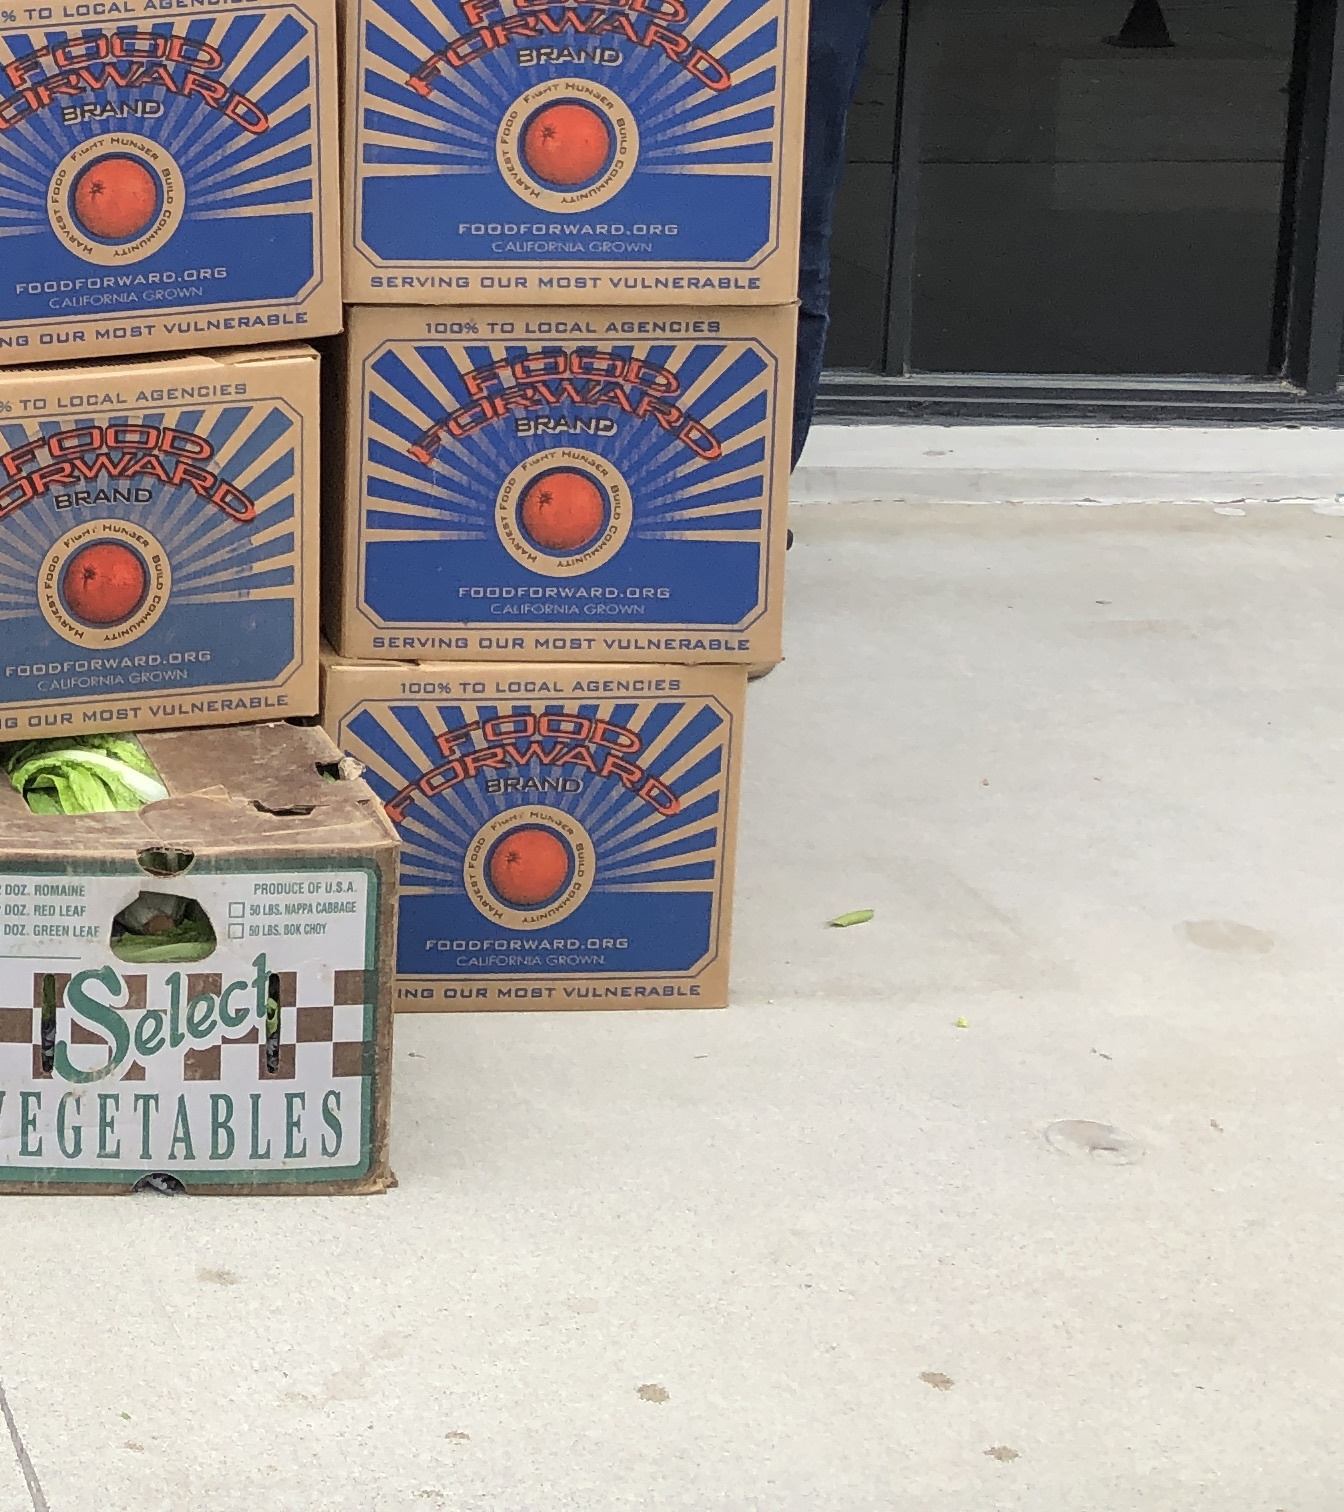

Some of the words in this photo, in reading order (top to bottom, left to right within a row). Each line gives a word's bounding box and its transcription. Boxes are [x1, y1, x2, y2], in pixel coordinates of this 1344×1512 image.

[2, 31, 225, 90] FOOD
[405, 8, 733, 97] FORWARD
[517, 48, 624, 67] BRAND
[61, 98, 164, 126] BRAND
[458, 223, 679, 237] FOODFORWARD.ORG
[15, 266, 227, 297] FOODFORWARD.ORG
[460, 352, 683, 398] FOOD
[407, 380, 723, 466] FORWARD
[515, 418, 618, 437] BRAND
[53, 488, 153, 514] BRAND
[457, 587, 670, 600] FOODFORWARD.ORG
[6, 651, 211, 680] FOODFORWARD.ORG
[434, 712, 645, 758] FOOD
[384, 740, 681, 823] FORWARD
[484, 776, 583, 796] BRAND
[5, 884, 30, 896] DOZ.
[34, 884, 86, 897] ROMAINE
[254, 882, 304, 896] PRODUCE
[308, 882, 322, 894] OF
[324, 881, 358, 894] U.S.A.
[4, 904, 30, 916] DOZ.
[34, 904, 56, 916] RED
[59, 905, 86, 918] LEAF
[249, 904, 260, 916] 50
[263, 904, 282, 916] LBS.
[284, 902, 313, 915] NAPPA
[316, 901, 356, 914] CABBAGE
[4, 924, 30, 936] DOZ.
[33, 924, 70, 937] GREEN
[72, 926, 100, 938] LEAF
[248, 924, 260, 936] 50
[262, 924, 281, 936] LBS.
[284, 923, 302, 936] BOK
[304, 922, 327, 934] CHOY
[427, 939, 628, 952] FOODFORWARD.ORG
[53, 952, 274, 1084] Select
